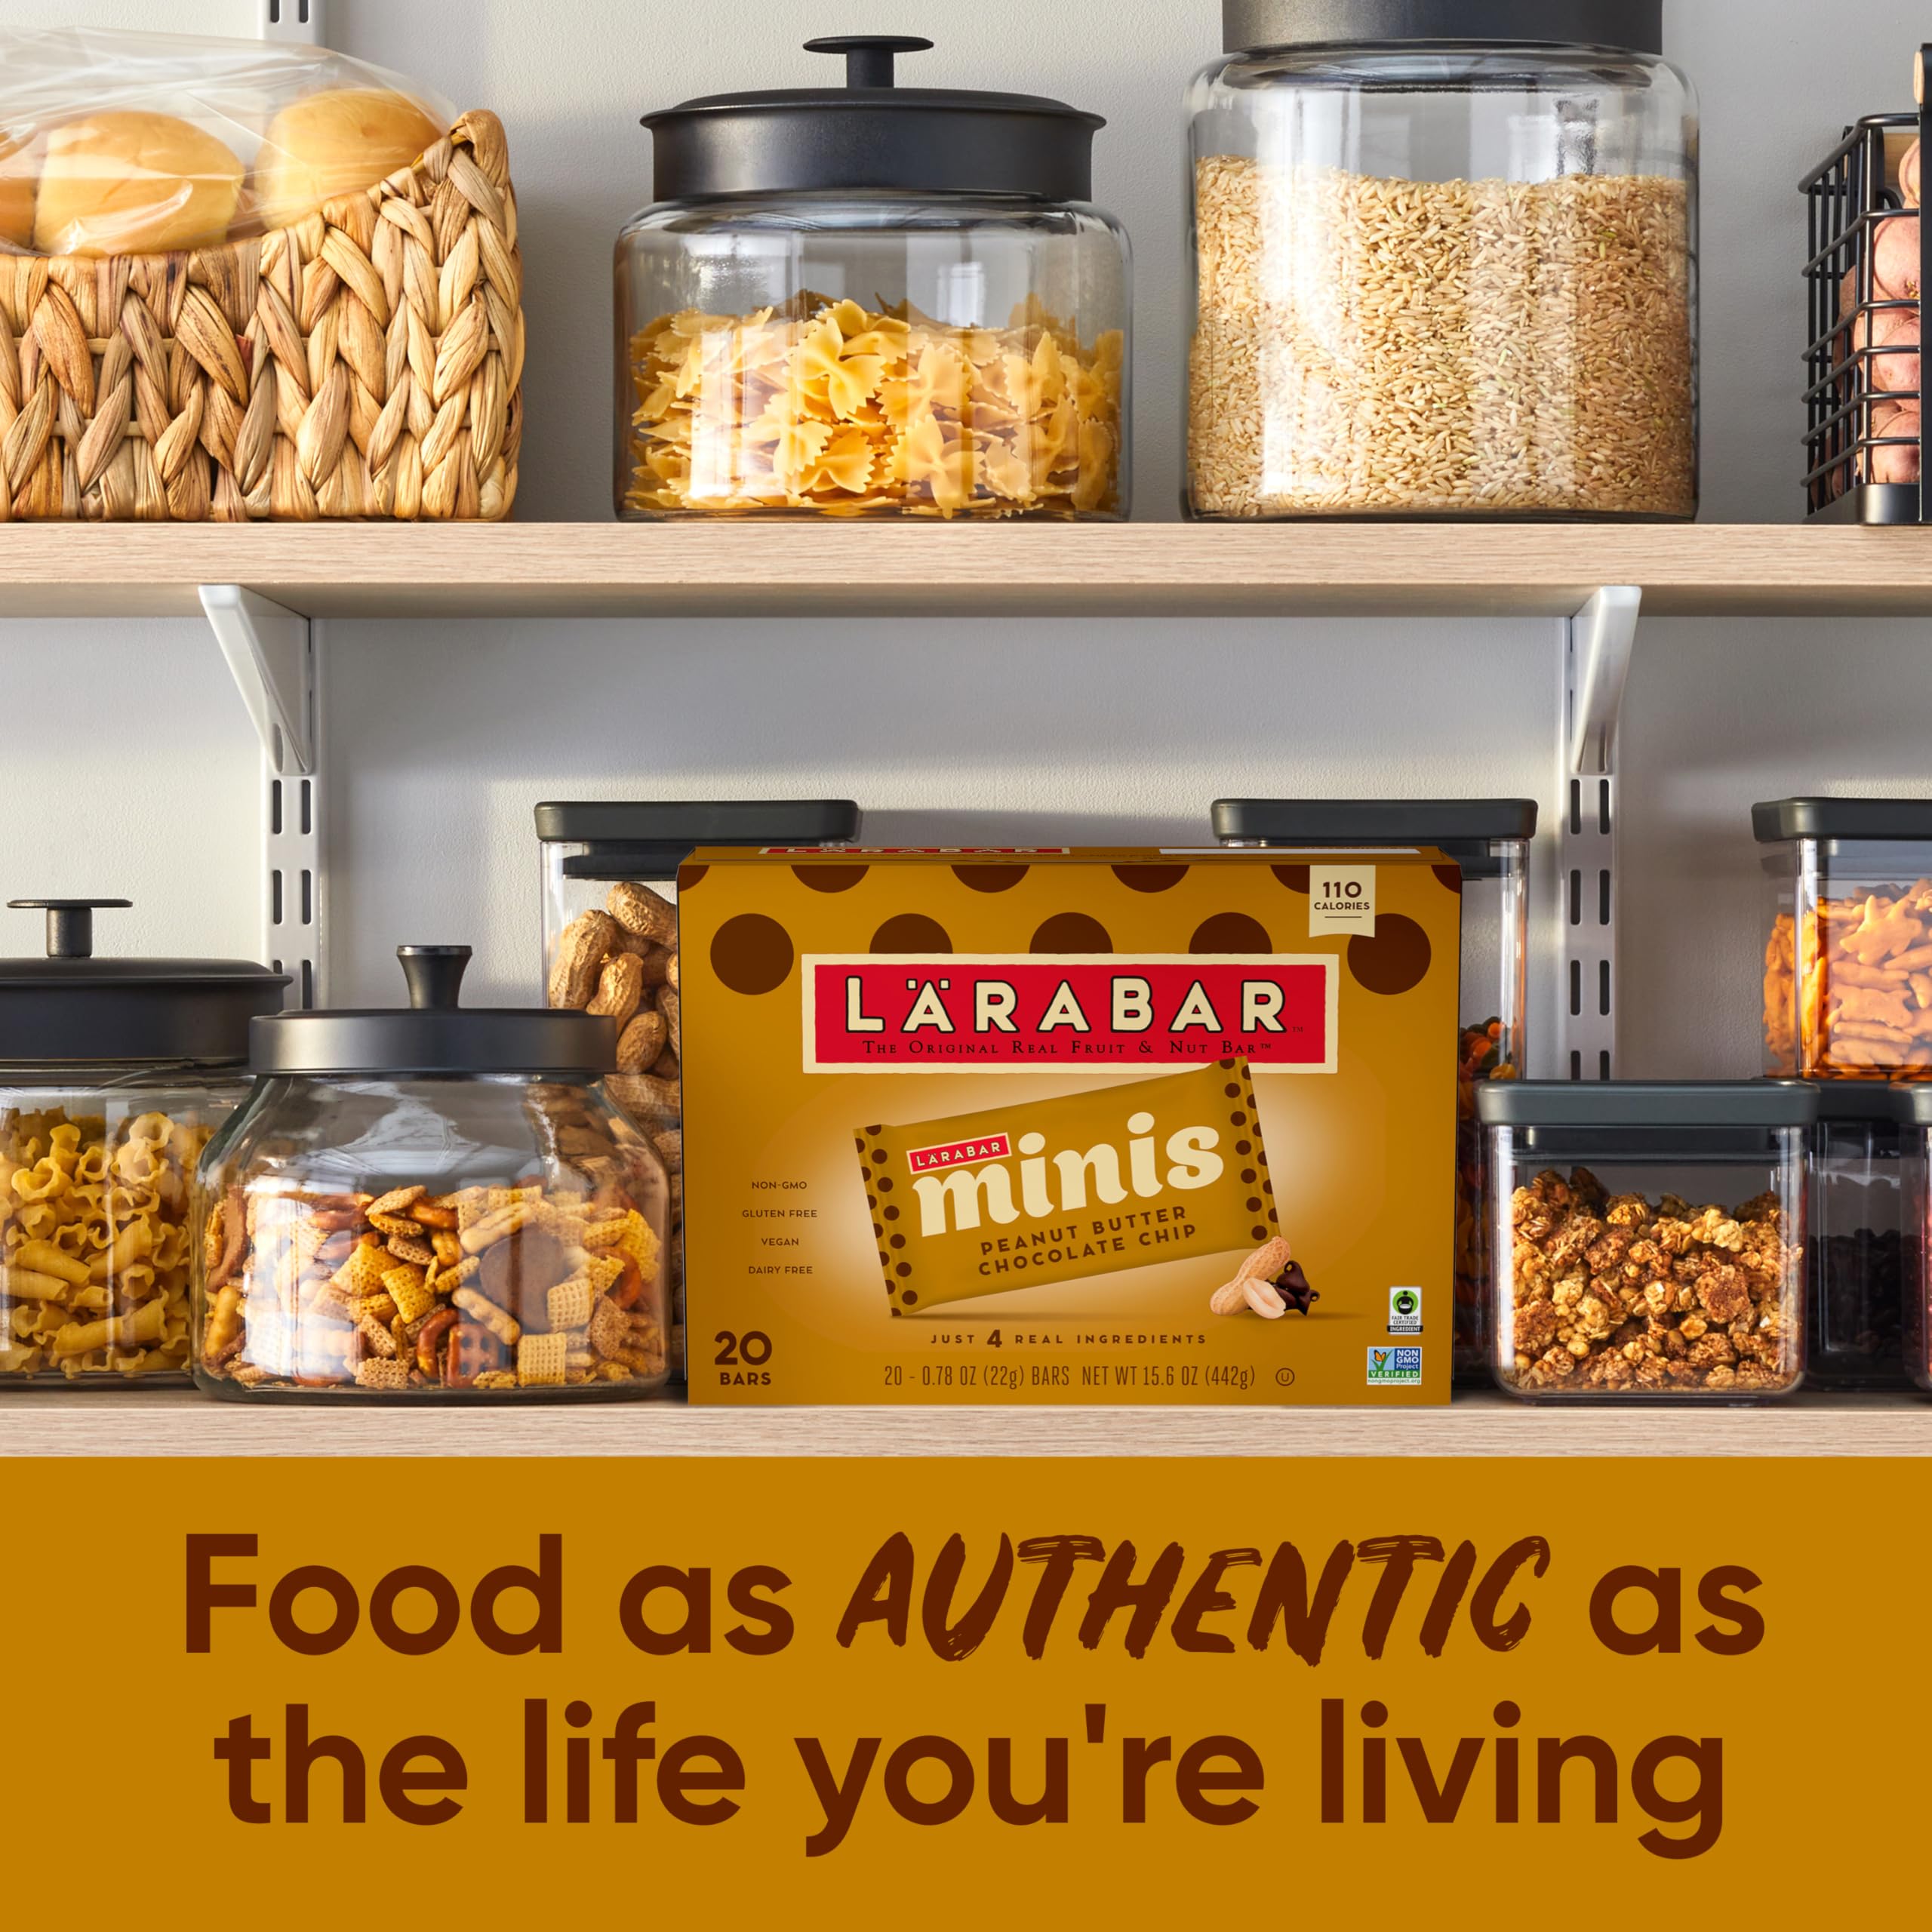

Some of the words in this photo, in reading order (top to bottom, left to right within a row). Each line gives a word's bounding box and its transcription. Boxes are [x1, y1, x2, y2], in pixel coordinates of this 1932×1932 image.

[1322, 881, 1362, 899] 110
[1314, 902, 1370, 910] CALORIES
[846, 976, 1287, 1033] LÄRABAR
[1138, 1040, 1153, 1054] &
[915, 1141, 1002, 1168] LÄRABAR
[912, 1112, 1224, 1237] minis
[751, 1180, 808, 1190] NON-GMO
[742, 1209, 785, 1218] GLUTEN
[789, 1209, 817, 1218] FREE
[981, 1226, 1078, 1256] PEANUT
[1093, 1206, 1186, 1235] BUTTER
[761, 1238, 799, 1246] VEGAN
[979, 1237, 1126, 1275] CHOCOLATE
[1139, 1224, 1196, 1247] CHIP
[748, 1266, 781, 1275] DAIRY
[785, 1266, 813, 1275] FREE
[714, 1331, 773, 1366] 20
[931, 1334, 974, 1344] JUST
[986, 1329, 1003, 1349] 4
[1015, 1334, 1063, 1344] REAL
[1077, 1334, 1206, 1344] INGREDIENTS
[719, 1372, 771, 1386] BARS
[884, 1365, 902, 1386] 20
[922, 1365, 952, 1386] 0.78
[960, 1365, 977, 1386] OZ
[983, 1365, 1024, 1390] (22g)
[1032, 1365, 1069, 1386] BARS
[1082, 1365, 1109, 1386] NET
[1115, 1365, 1137, 1386] WT
[1143, 1365, 1174, 1386] 15.6
[1181, 1365, 1198, 1386] OZ
[1205, 1365, 1255, 1390] (442g)
